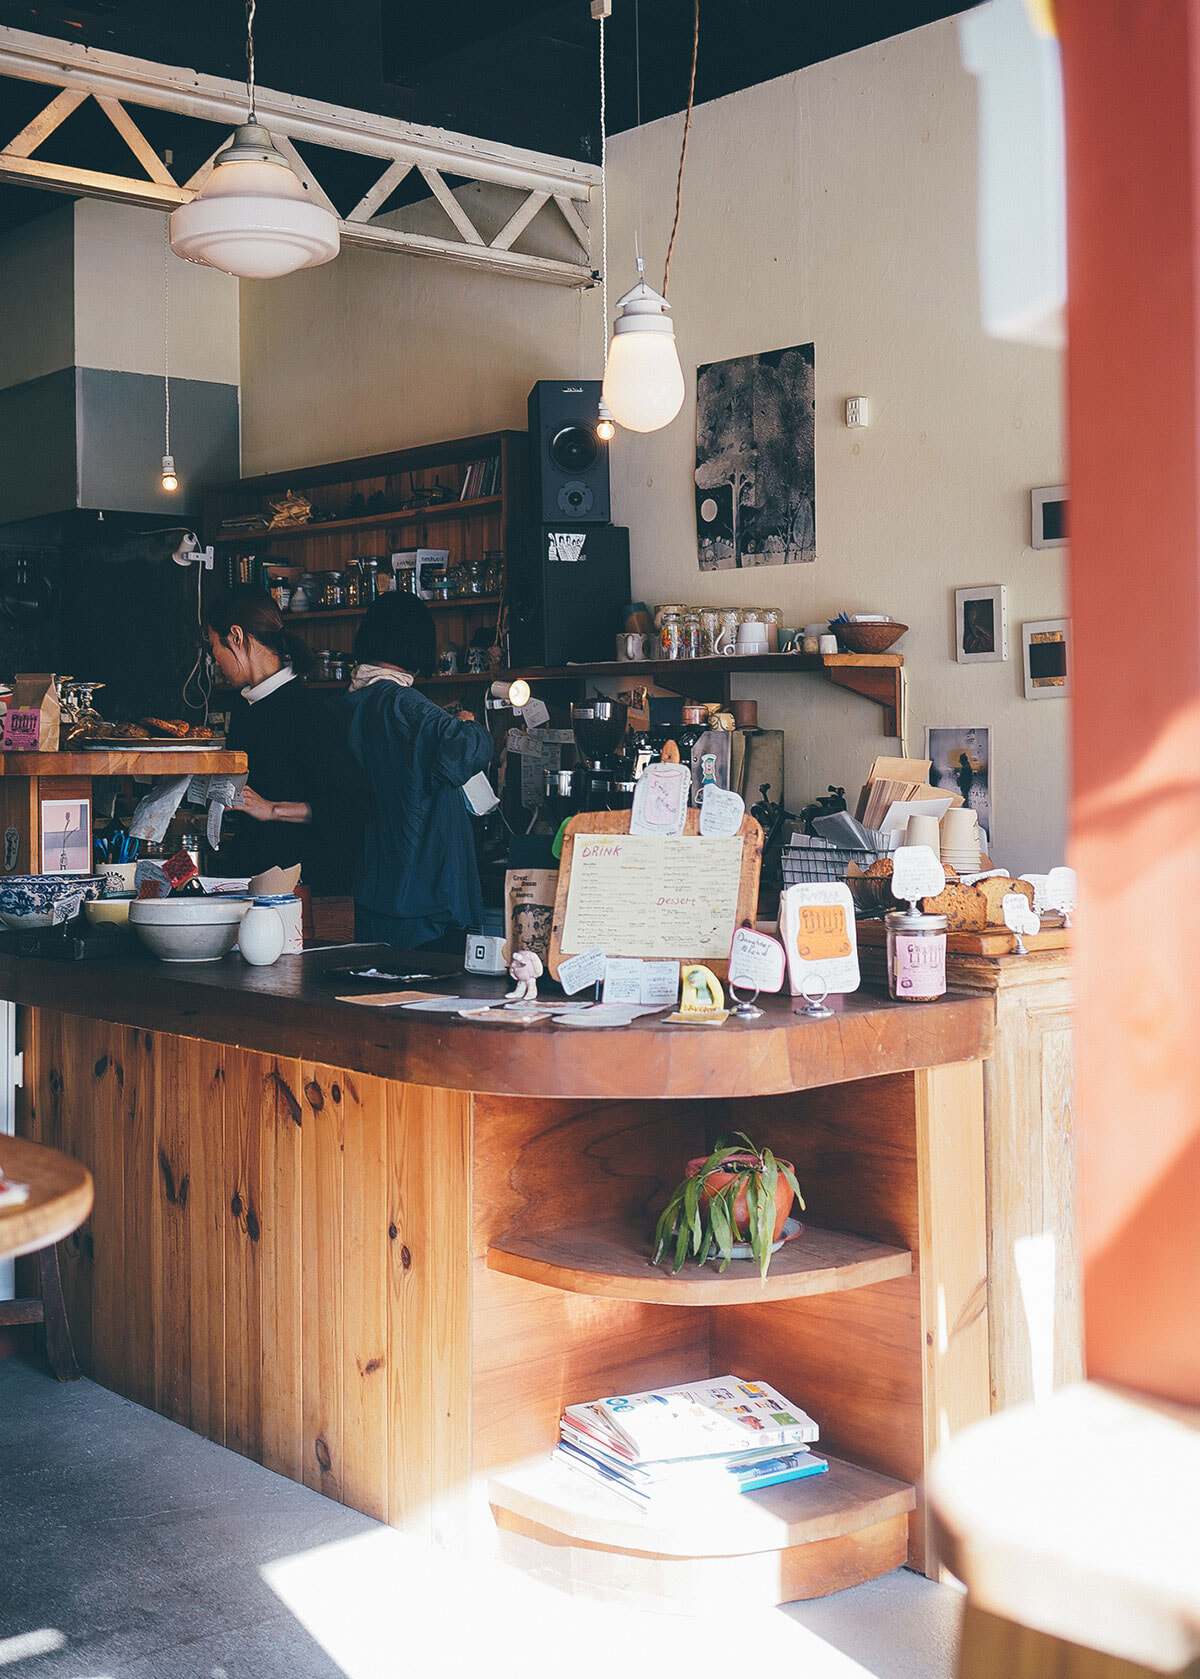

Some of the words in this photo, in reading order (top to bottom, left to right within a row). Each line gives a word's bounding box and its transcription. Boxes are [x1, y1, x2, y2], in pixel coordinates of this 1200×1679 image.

[581, 845, 623, 858] DRINK
[656, 897, 697, 907] Dessert
[737, 931, 772, 949] Daughter
[740, 944, 769, 957] Blend
